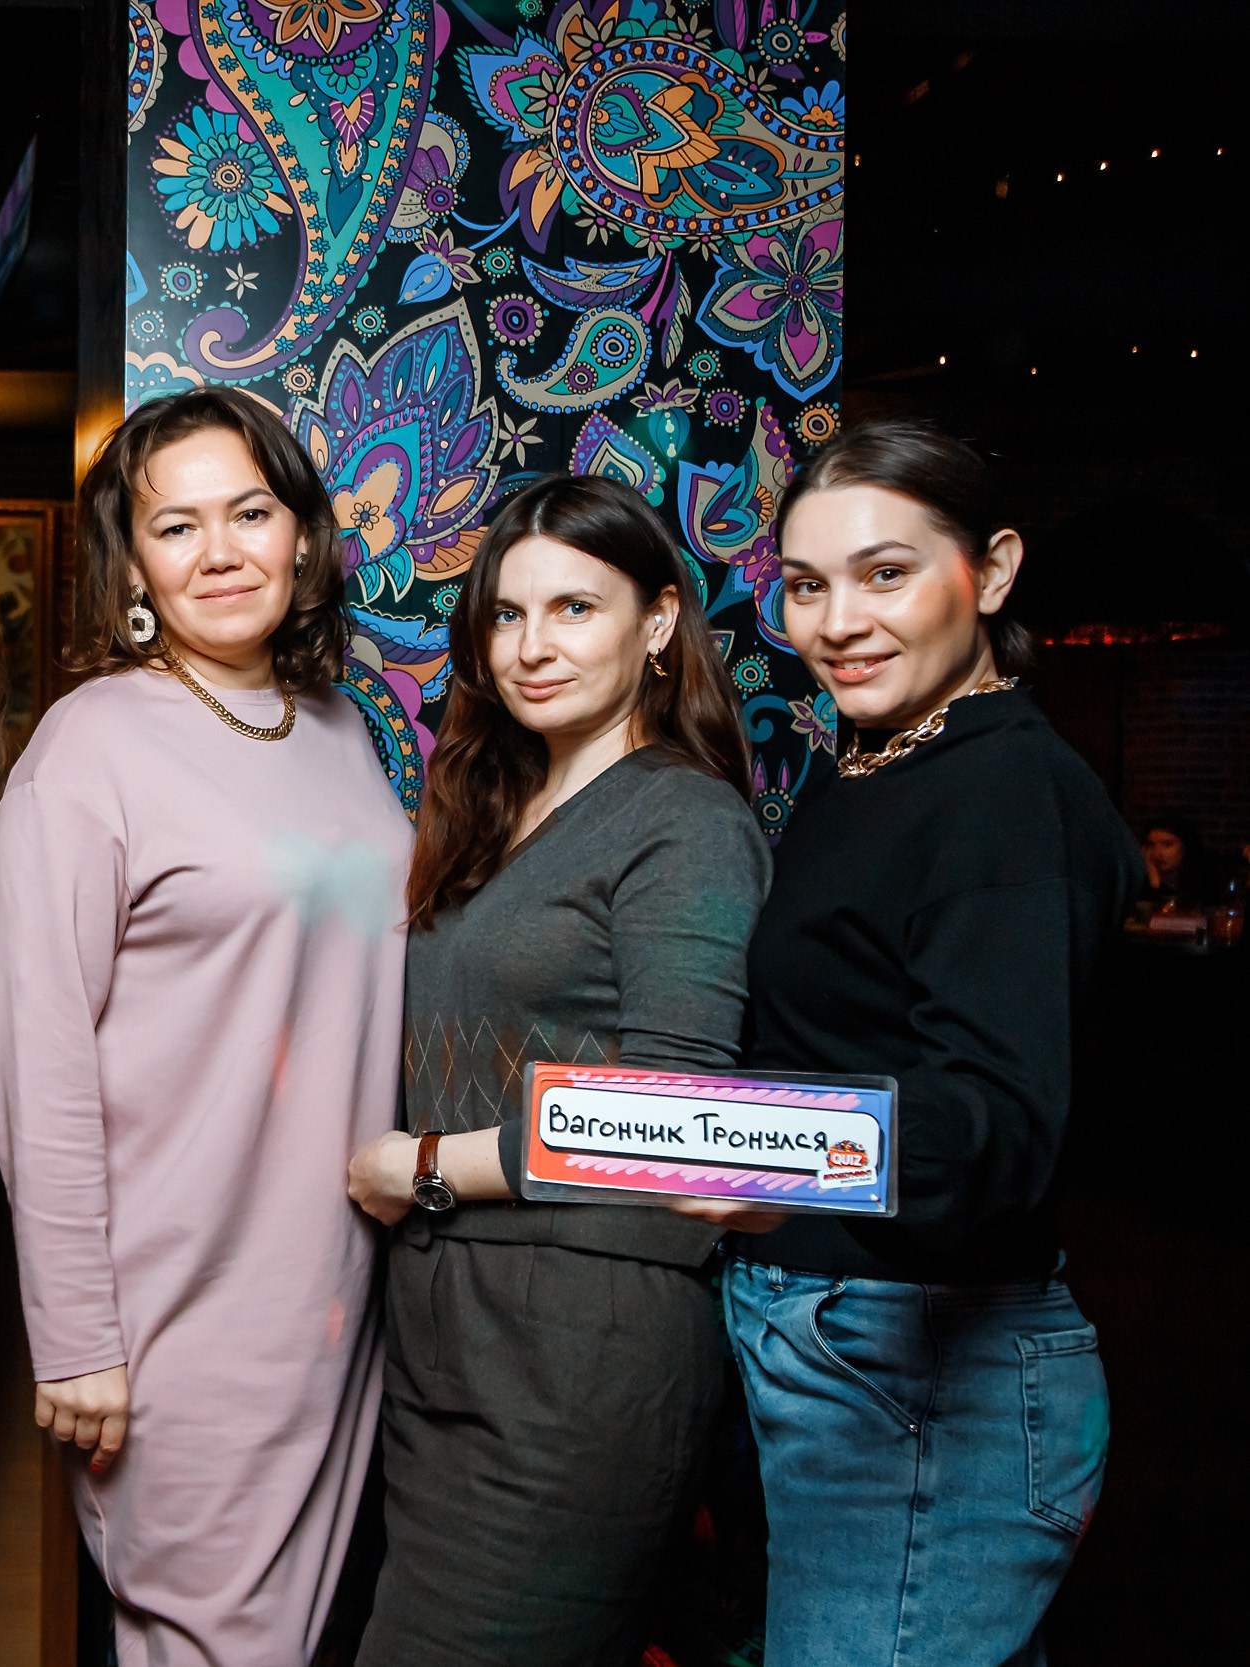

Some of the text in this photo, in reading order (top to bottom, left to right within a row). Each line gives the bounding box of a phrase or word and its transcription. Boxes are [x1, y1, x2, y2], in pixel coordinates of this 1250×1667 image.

[549, 1103, 829, 1153] Вагончик Тронулся
[831, 1153, 863, 1168] QUIZ
